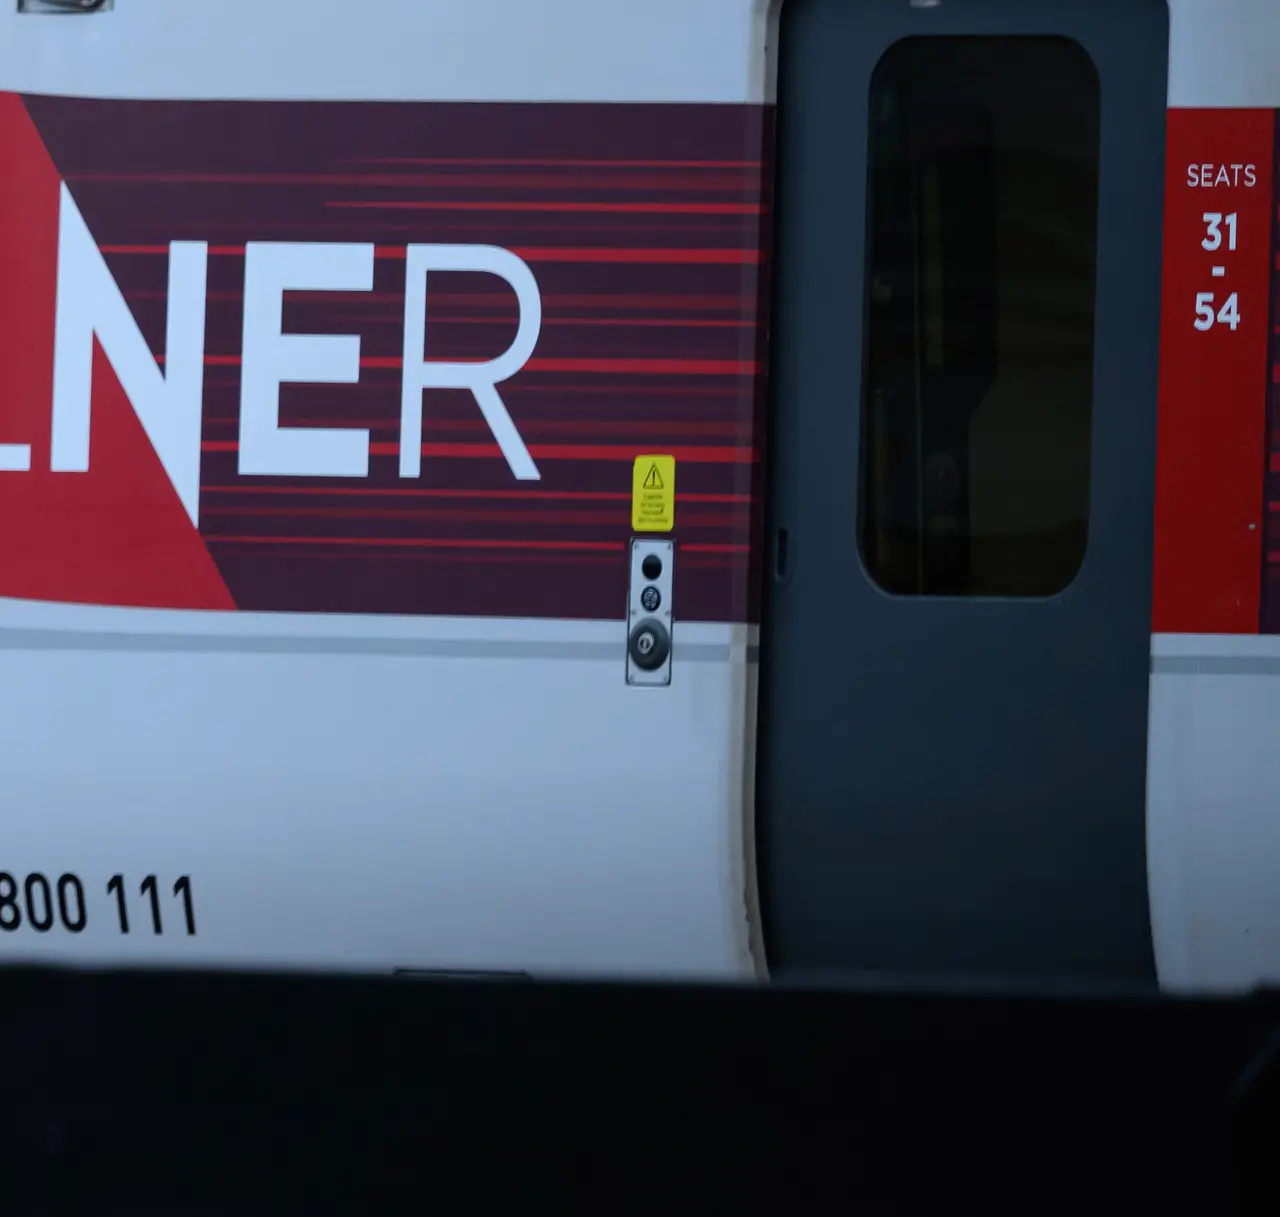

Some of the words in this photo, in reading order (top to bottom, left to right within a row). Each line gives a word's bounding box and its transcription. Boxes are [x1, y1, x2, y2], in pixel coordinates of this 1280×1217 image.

[1186, 163, 1257, 188] SEATS
[1201, 211, 1238, 251] 31
[1193, 291, 1241, 331] 54
[106, 873, 196, 935] 111
